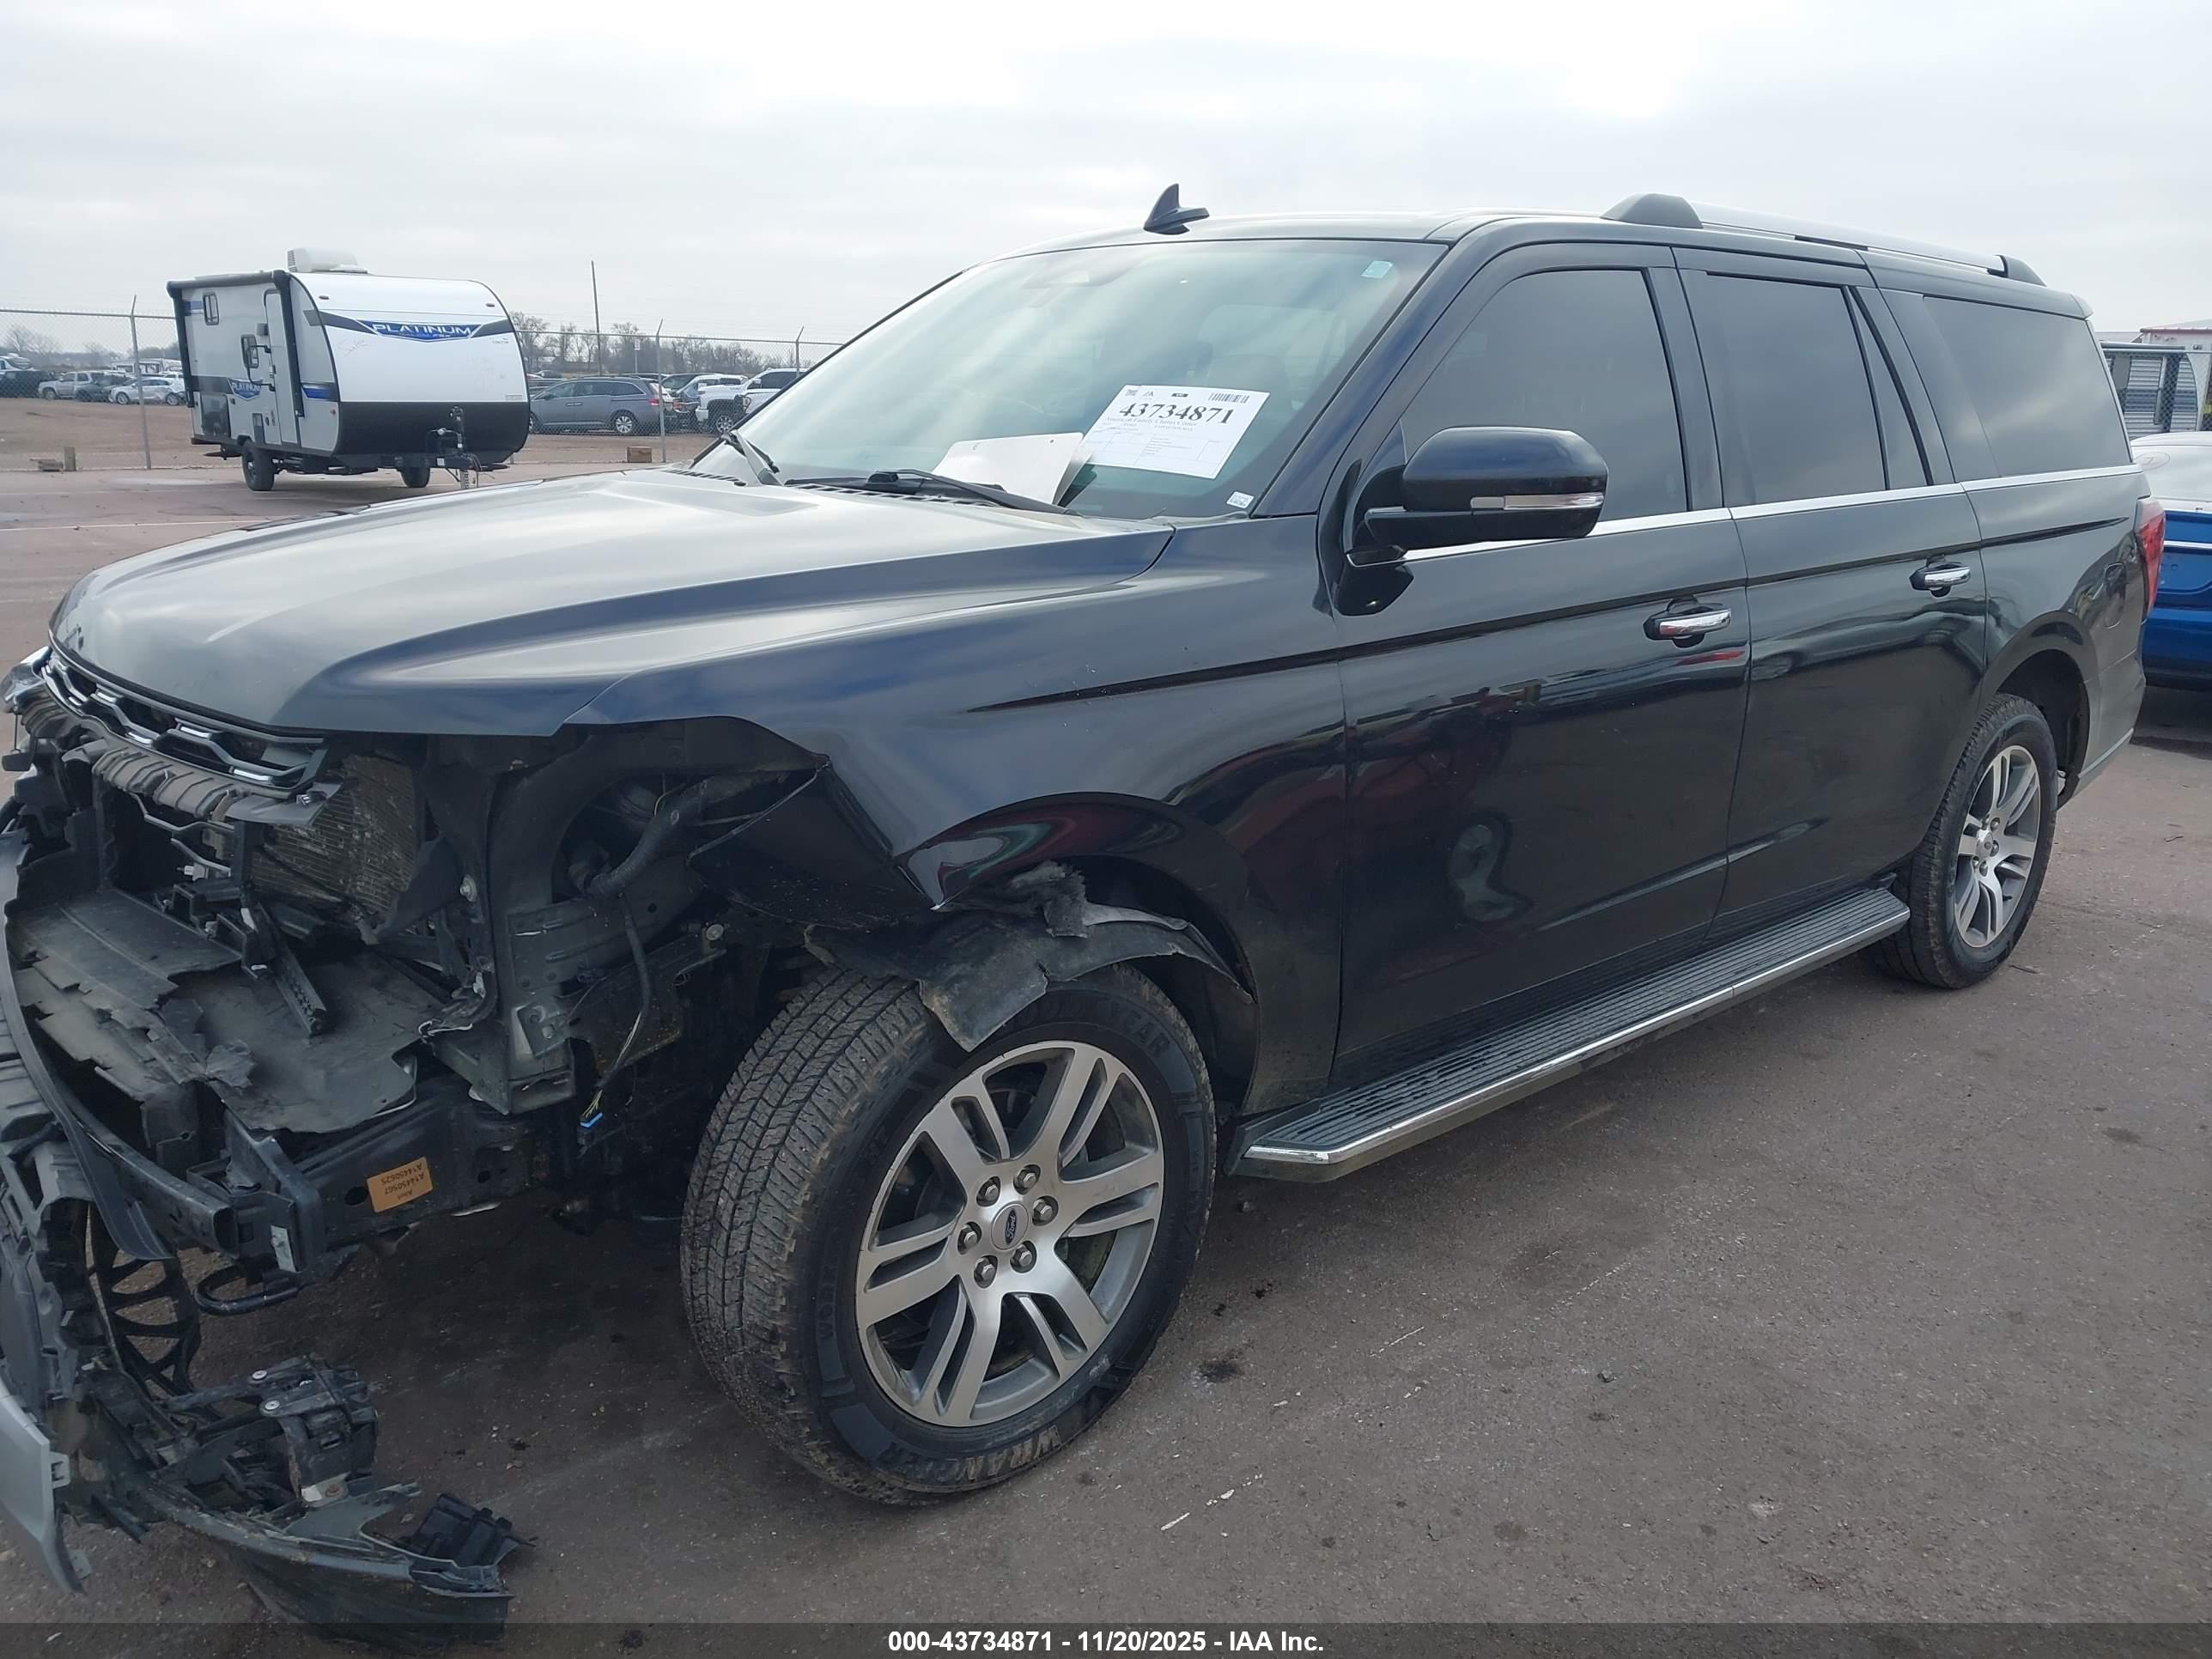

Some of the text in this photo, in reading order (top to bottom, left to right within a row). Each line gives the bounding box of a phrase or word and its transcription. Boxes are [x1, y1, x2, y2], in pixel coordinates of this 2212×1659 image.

[372, 323, 471, 336] PLATINUM
[1119, 402, 1234, 424] 43734871
[1006, 1215, 1016, 1239] Ford
